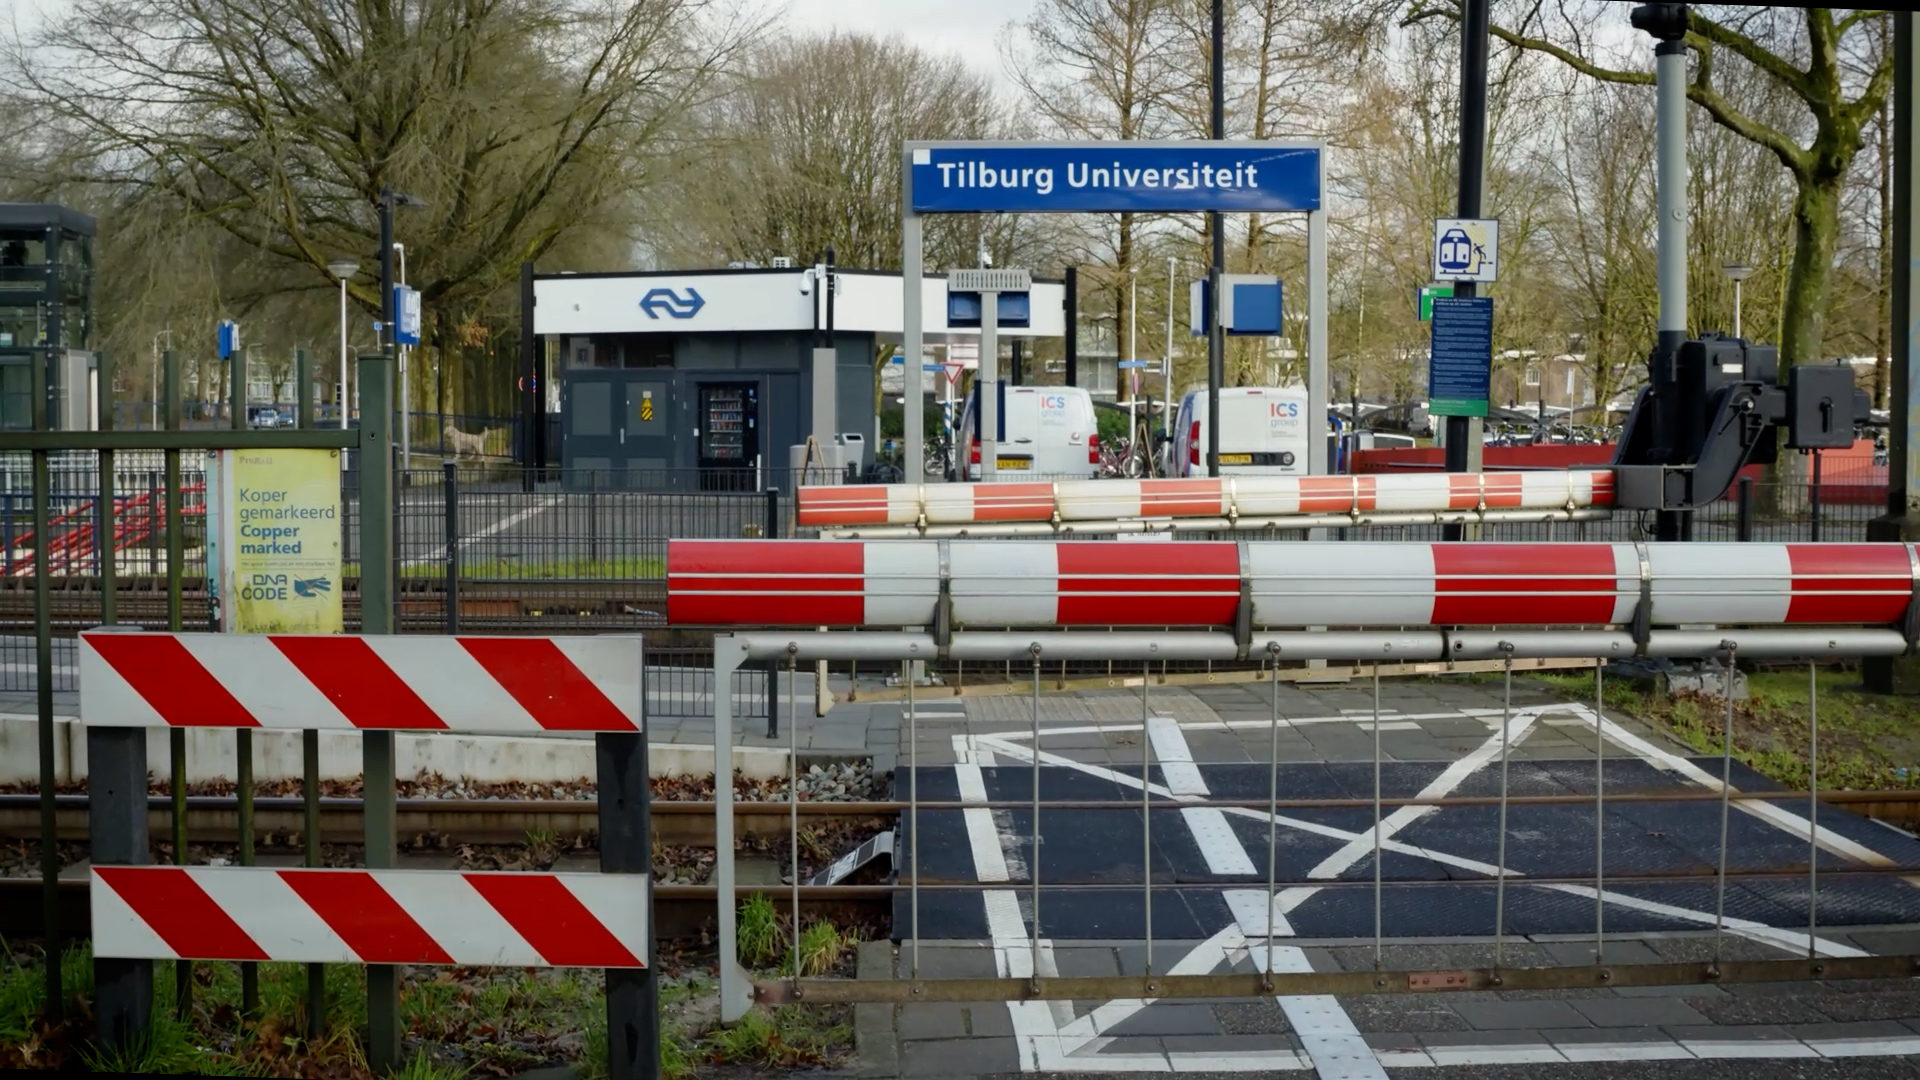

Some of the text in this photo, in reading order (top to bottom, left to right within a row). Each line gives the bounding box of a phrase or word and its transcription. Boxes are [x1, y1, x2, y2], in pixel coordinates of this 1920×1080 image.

[937, 160, 1258, 194] Tilburg Universiteit
[1041, 396, 1065, 409] ICS
[1271, 402, 1298, 417] ICS
[240, 488, 287, 505] Koper
[240, 505, 335, 523] gemarkeerd
[240, 525, 300, 540] Copper
[241, 540, 302, 554] marked
[253, 574, 288, 586] DNA
[241, 588, 288, 601] CODE
